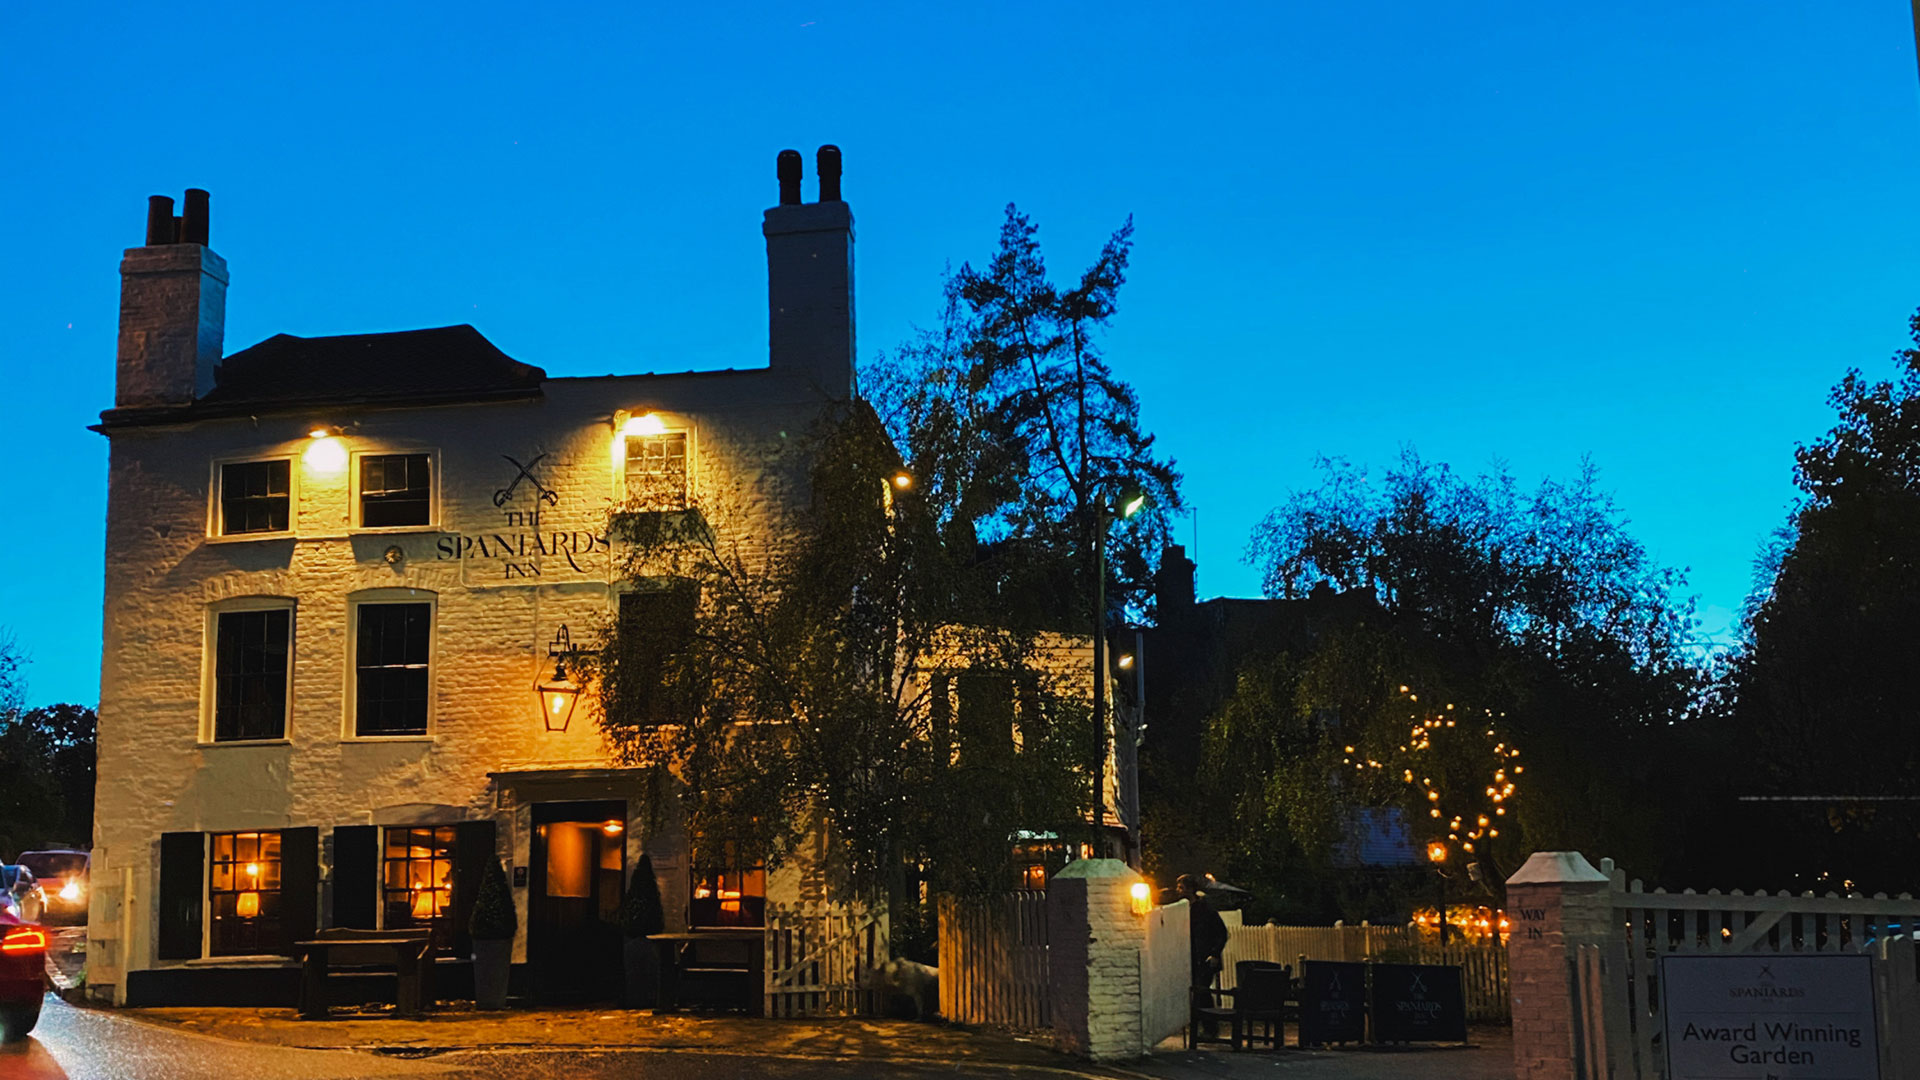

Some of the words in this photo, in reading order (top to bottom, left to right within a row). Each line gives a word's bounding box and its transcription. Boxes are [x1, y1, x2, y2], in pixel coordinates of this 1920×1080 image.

[504, 510, 546, 527] THE
[436, 531, 611, 574] SPANIARDS
[505, 562, 542, 580] INN
[1520, 908, 1546, 921] WAY
[1528, 926, 1543, 940] IN
[1729, 986, 1806, 999] SPANIARDS
[1682, 1021, 1756, 1042] Award
[1763, 1021, 1862, 1049] Winning
[1729, 1044, 1815, 1065] Garden
